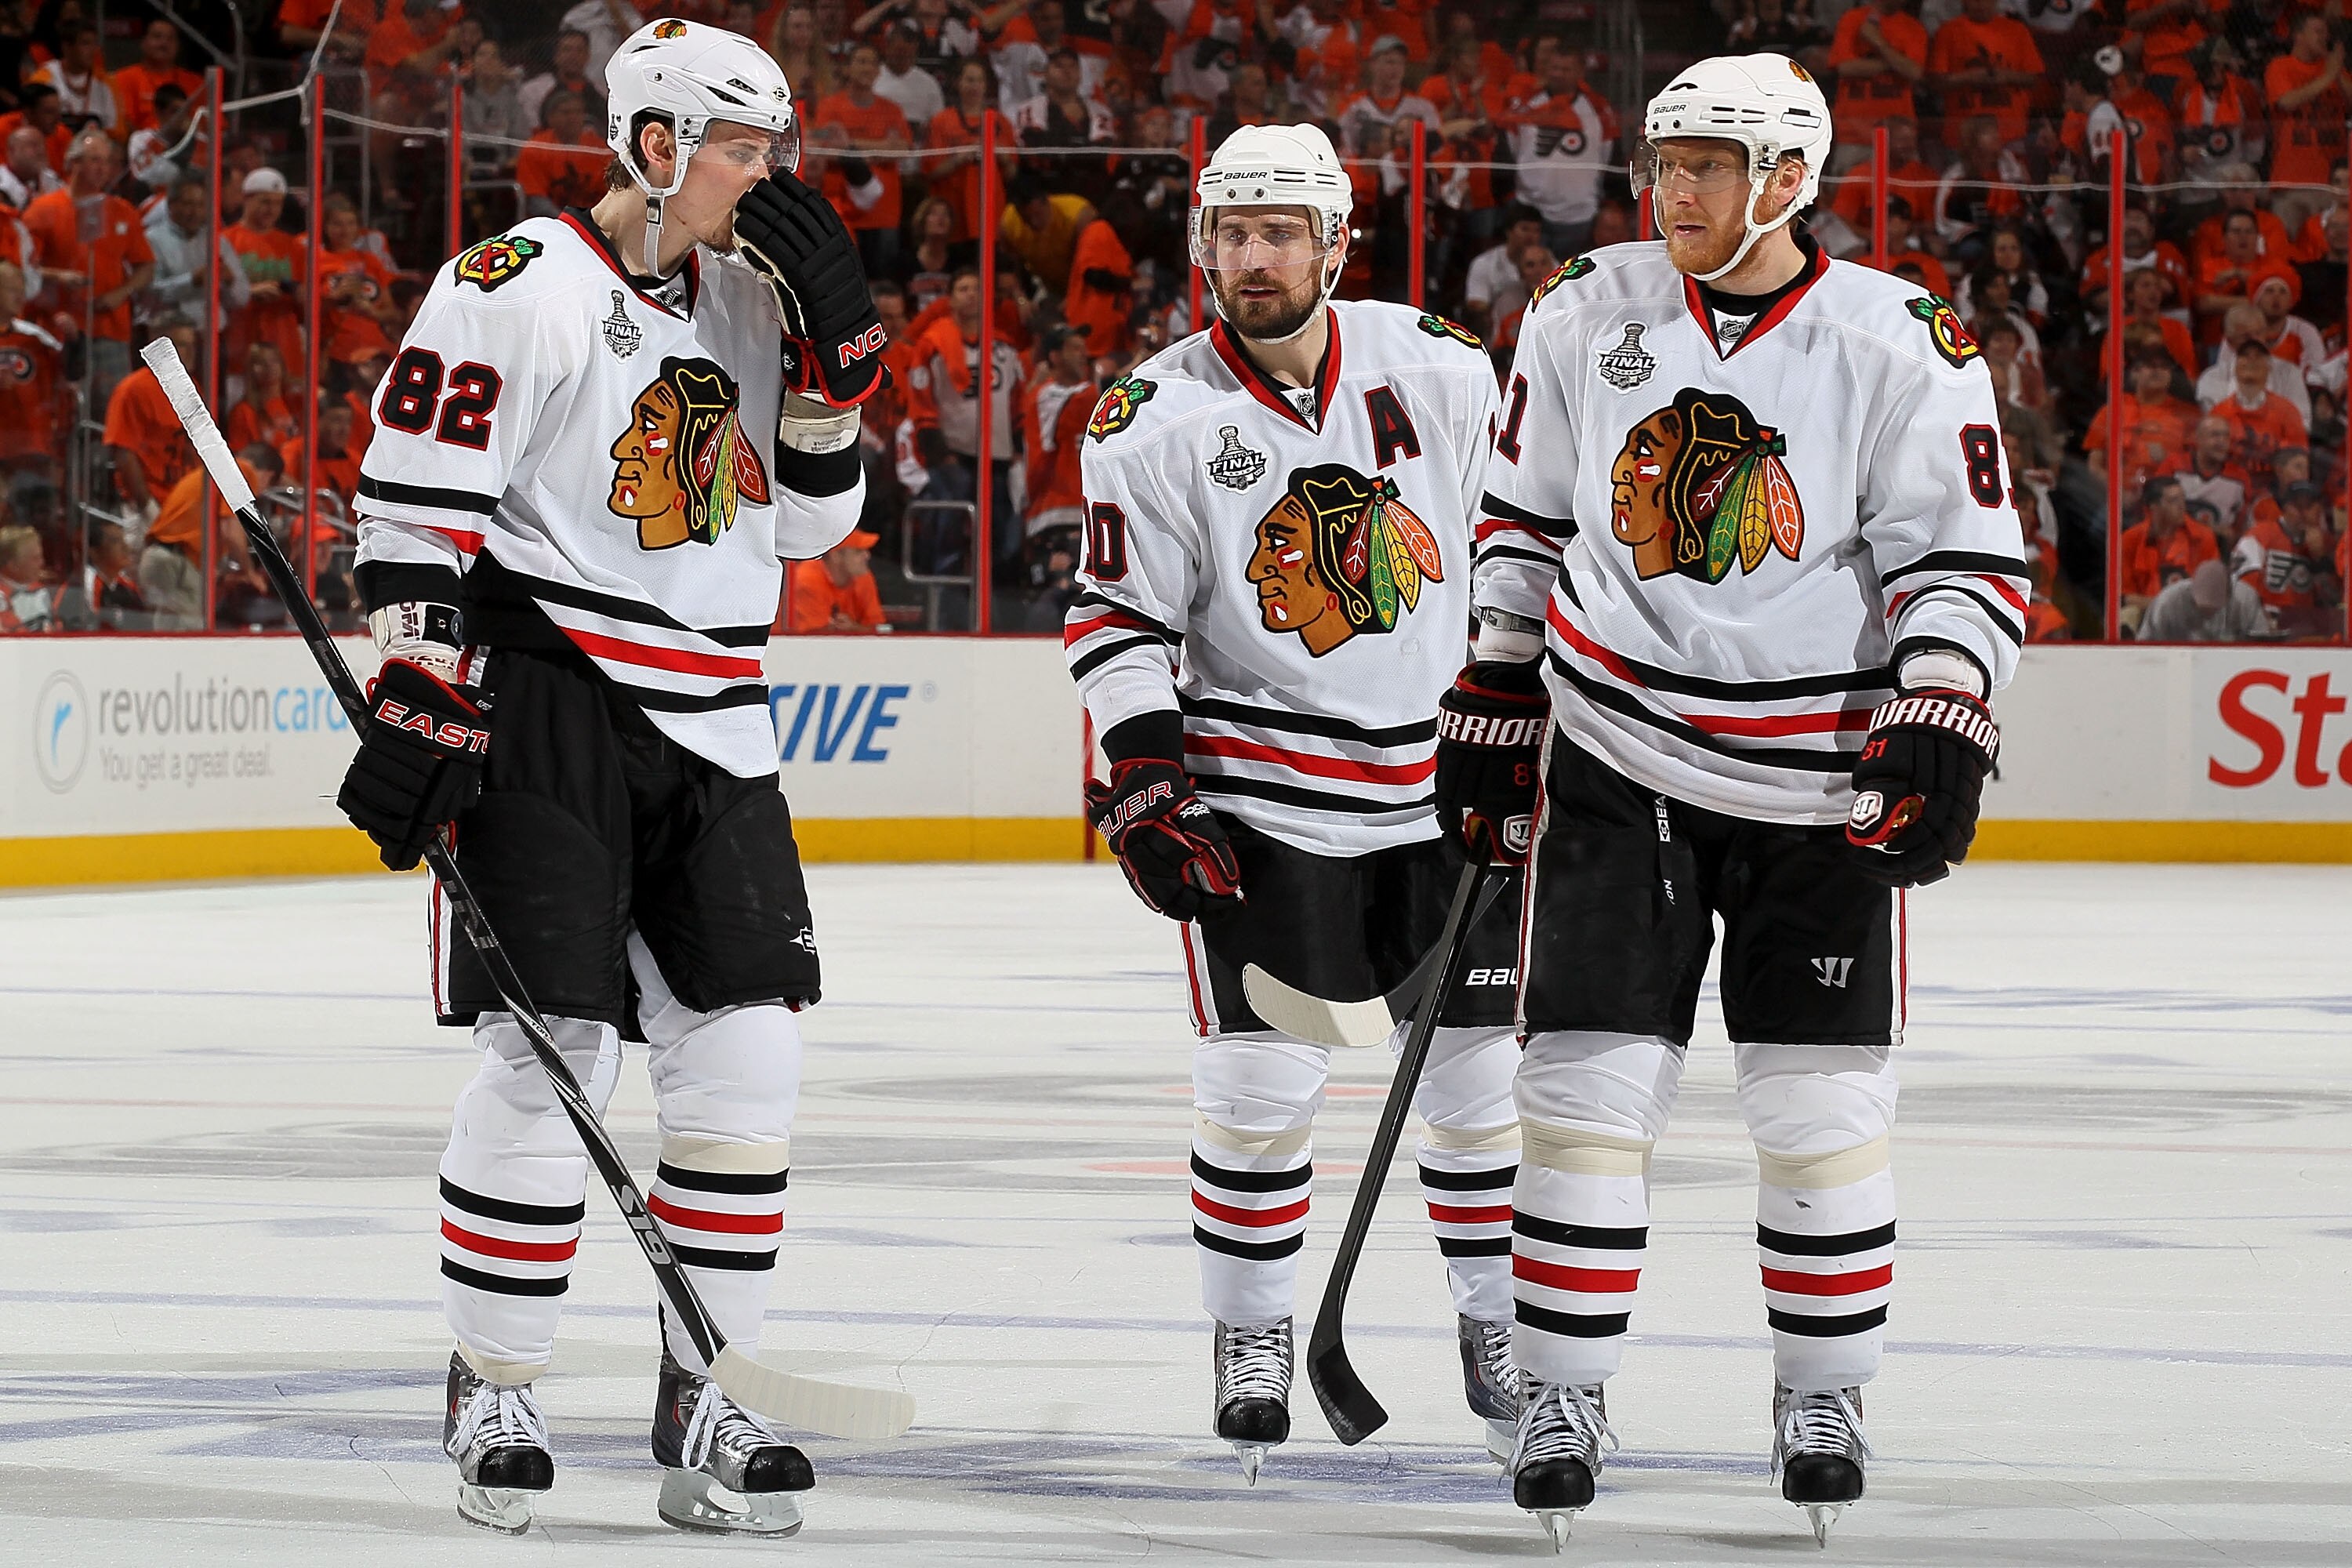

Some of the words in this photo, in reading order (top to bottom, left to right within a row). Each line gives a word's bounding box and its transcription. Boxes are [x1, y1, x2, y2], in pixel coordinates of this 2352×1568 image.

[604, 322, 641, 339] FINAL
[1601, 356, 1653, 368] FINAL
[378, 346, 504, 452] 82
[1364, 385, 1421, 471] A
[1212, 455, 1264, 474] FINAL
[1959, 423, 2019, 510] 8
[1869, 698, 1999, 760] WARRIOR
[2208, 668, 2352, 789] St
[611, 1184, 671, 1265] S19
